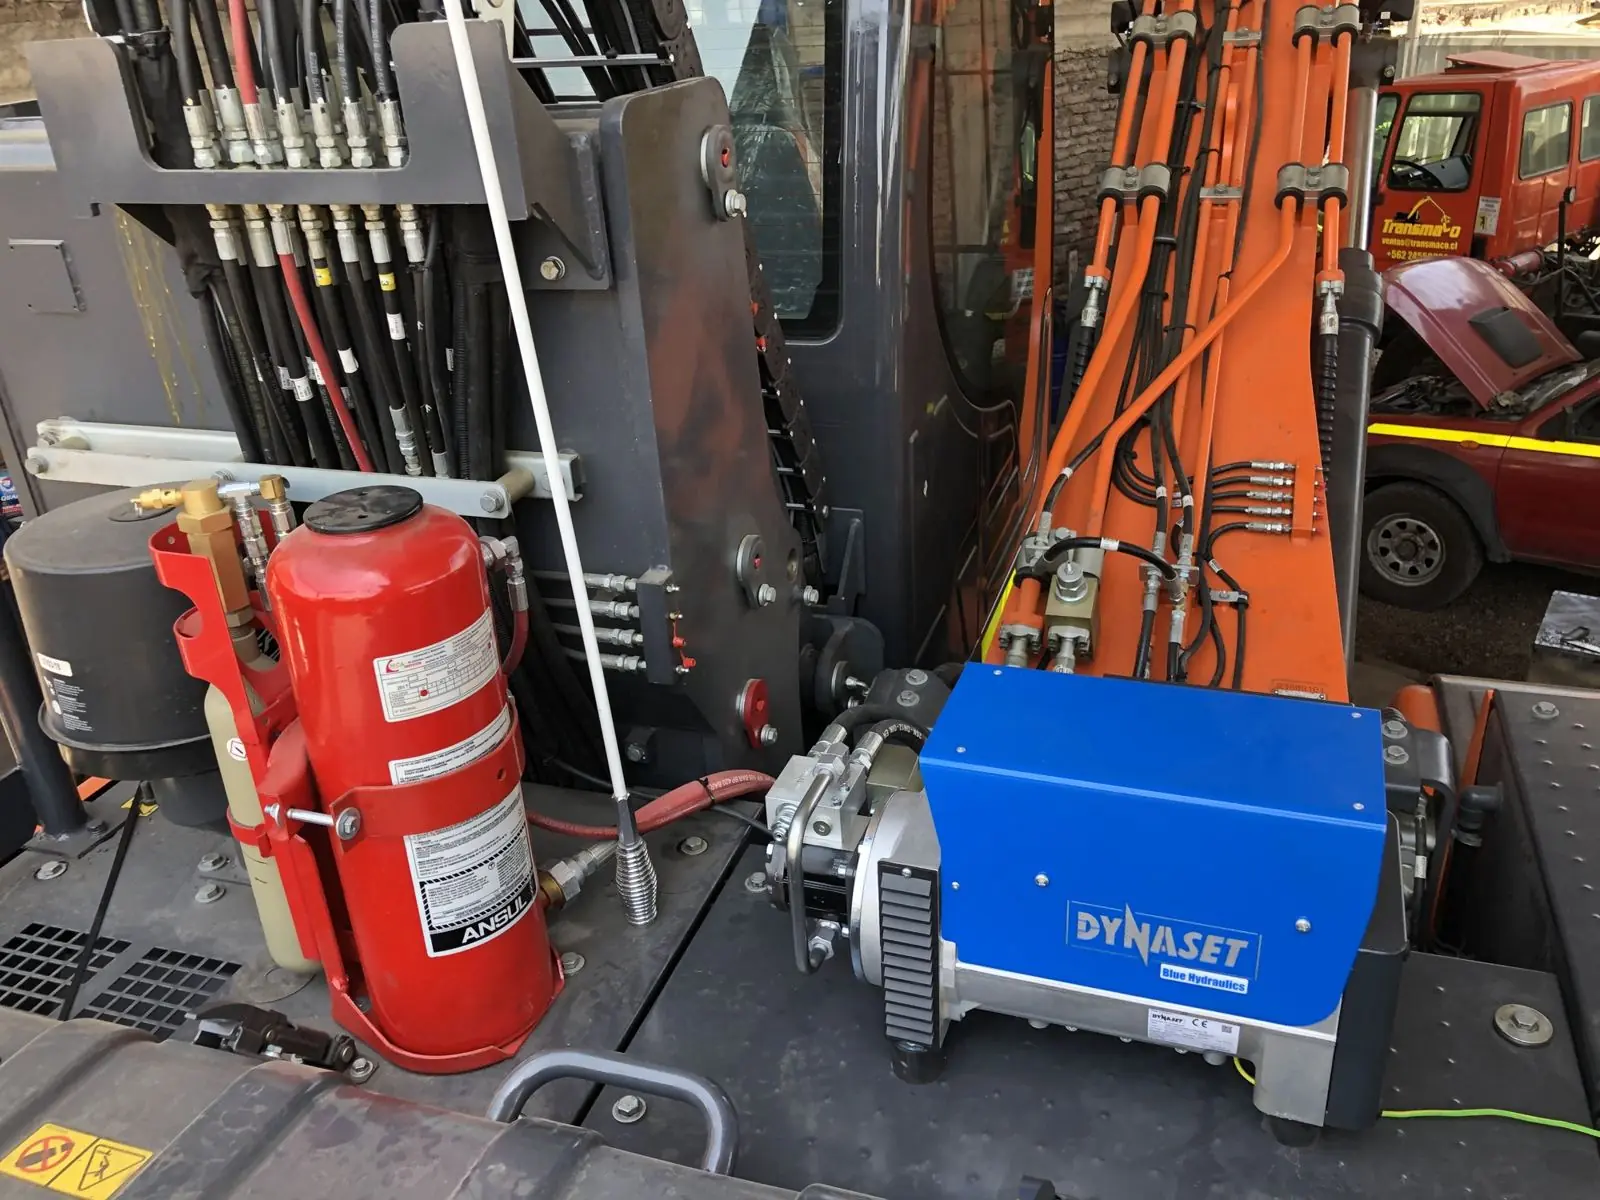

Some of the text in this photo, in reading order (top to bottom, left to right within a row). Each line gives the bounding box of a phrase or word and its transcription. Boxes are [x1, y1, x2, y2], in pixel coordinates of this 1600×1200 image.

[461, 895, 528, 944] ANSUL
[1076, 903, 1249, 967] DYNASET
[1162, 967, 1245, 992] Blue Hydraulics
